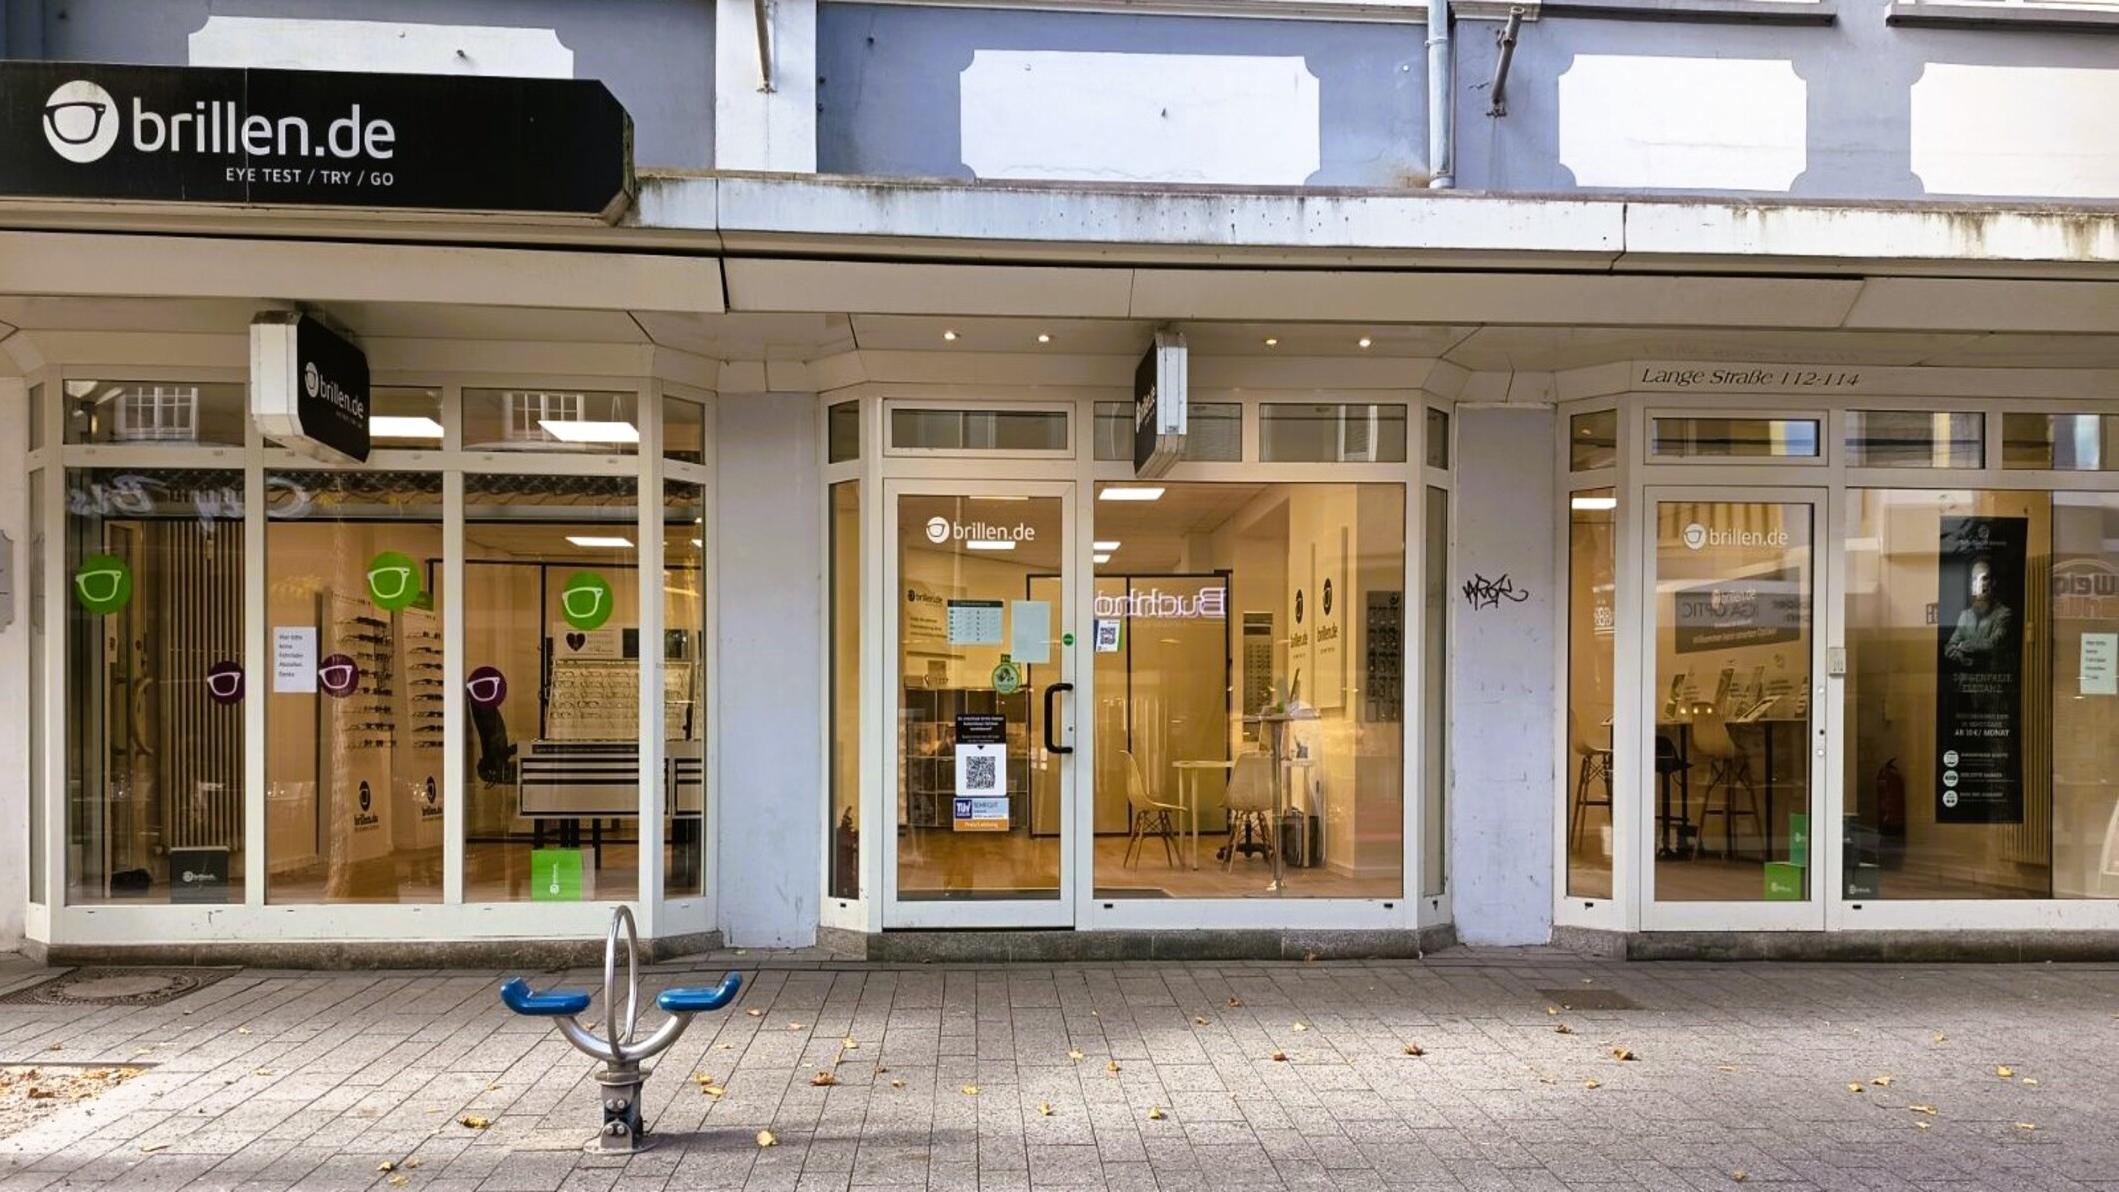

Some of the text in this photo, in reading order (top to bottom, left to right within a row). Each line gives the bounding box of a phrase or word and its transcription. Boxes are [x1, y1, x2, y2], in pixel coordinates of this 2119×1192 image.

[133, 96, 395, 159] brillen.de
[226, 167, 256, 182] EYE
[262, 168, 302, 183] TEST
[320, 170, 352, 185] TRY
[370, 172, 394, 186] GO
[1642, 367, 1861, 387] Lange Straße 112-114
[320, 374, 364, 418] brillen.de
[953, 521, 1035, 541] brillen.de
[1709, 527, 1789, 546] brillen.de
